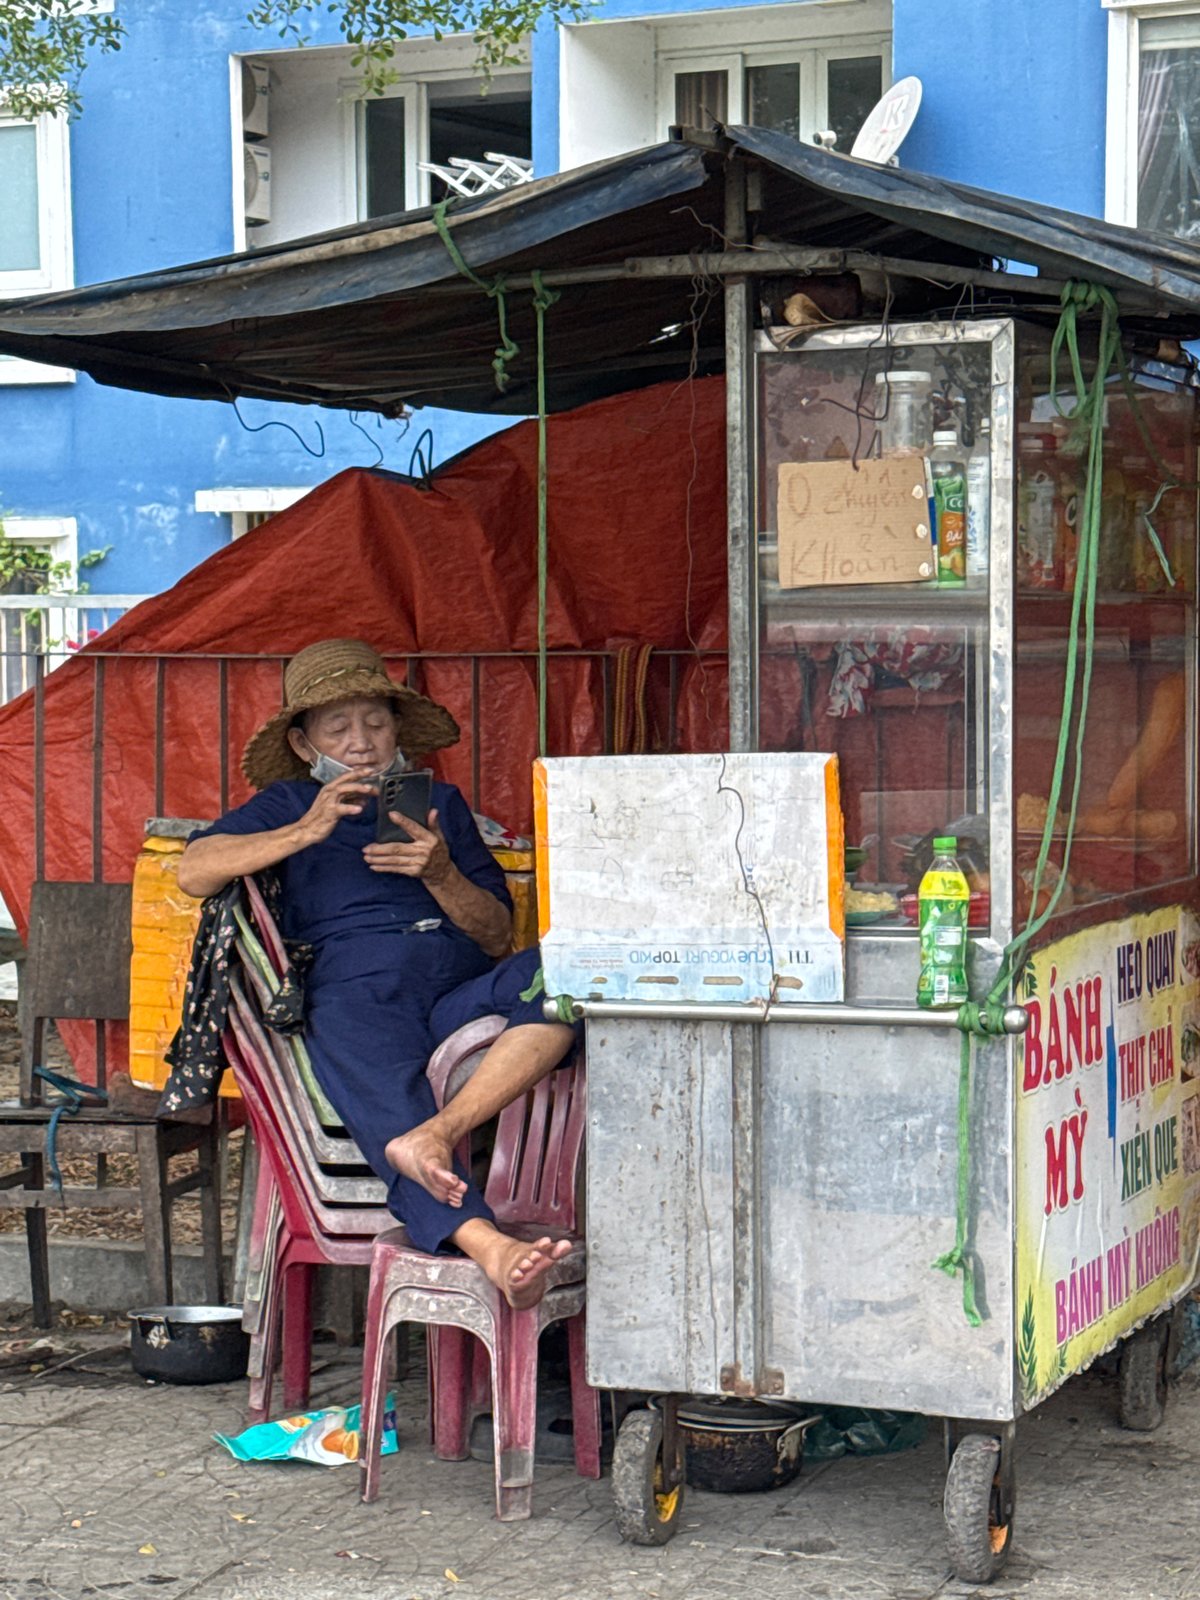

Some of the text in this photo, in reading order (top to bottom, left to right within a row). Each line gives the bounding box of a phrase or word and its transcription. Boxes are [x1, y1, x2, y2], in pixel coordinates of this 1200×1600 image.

[685, 950, 735, 964] YOGURT
[1117, 930, 1176, 1003] HEO QUAY
[1023, 966, 1103, 1092] BÁNH
[1119, 1005, 1174, 1108] THỊT CHẢ
[1045, 1088, 1088, 1216] MỲ
[1120, 1116, 1177, 1201] XIÊN QUE
[1055, 1206, 1180, 1345] BÁNH MỲ KHÔNG
